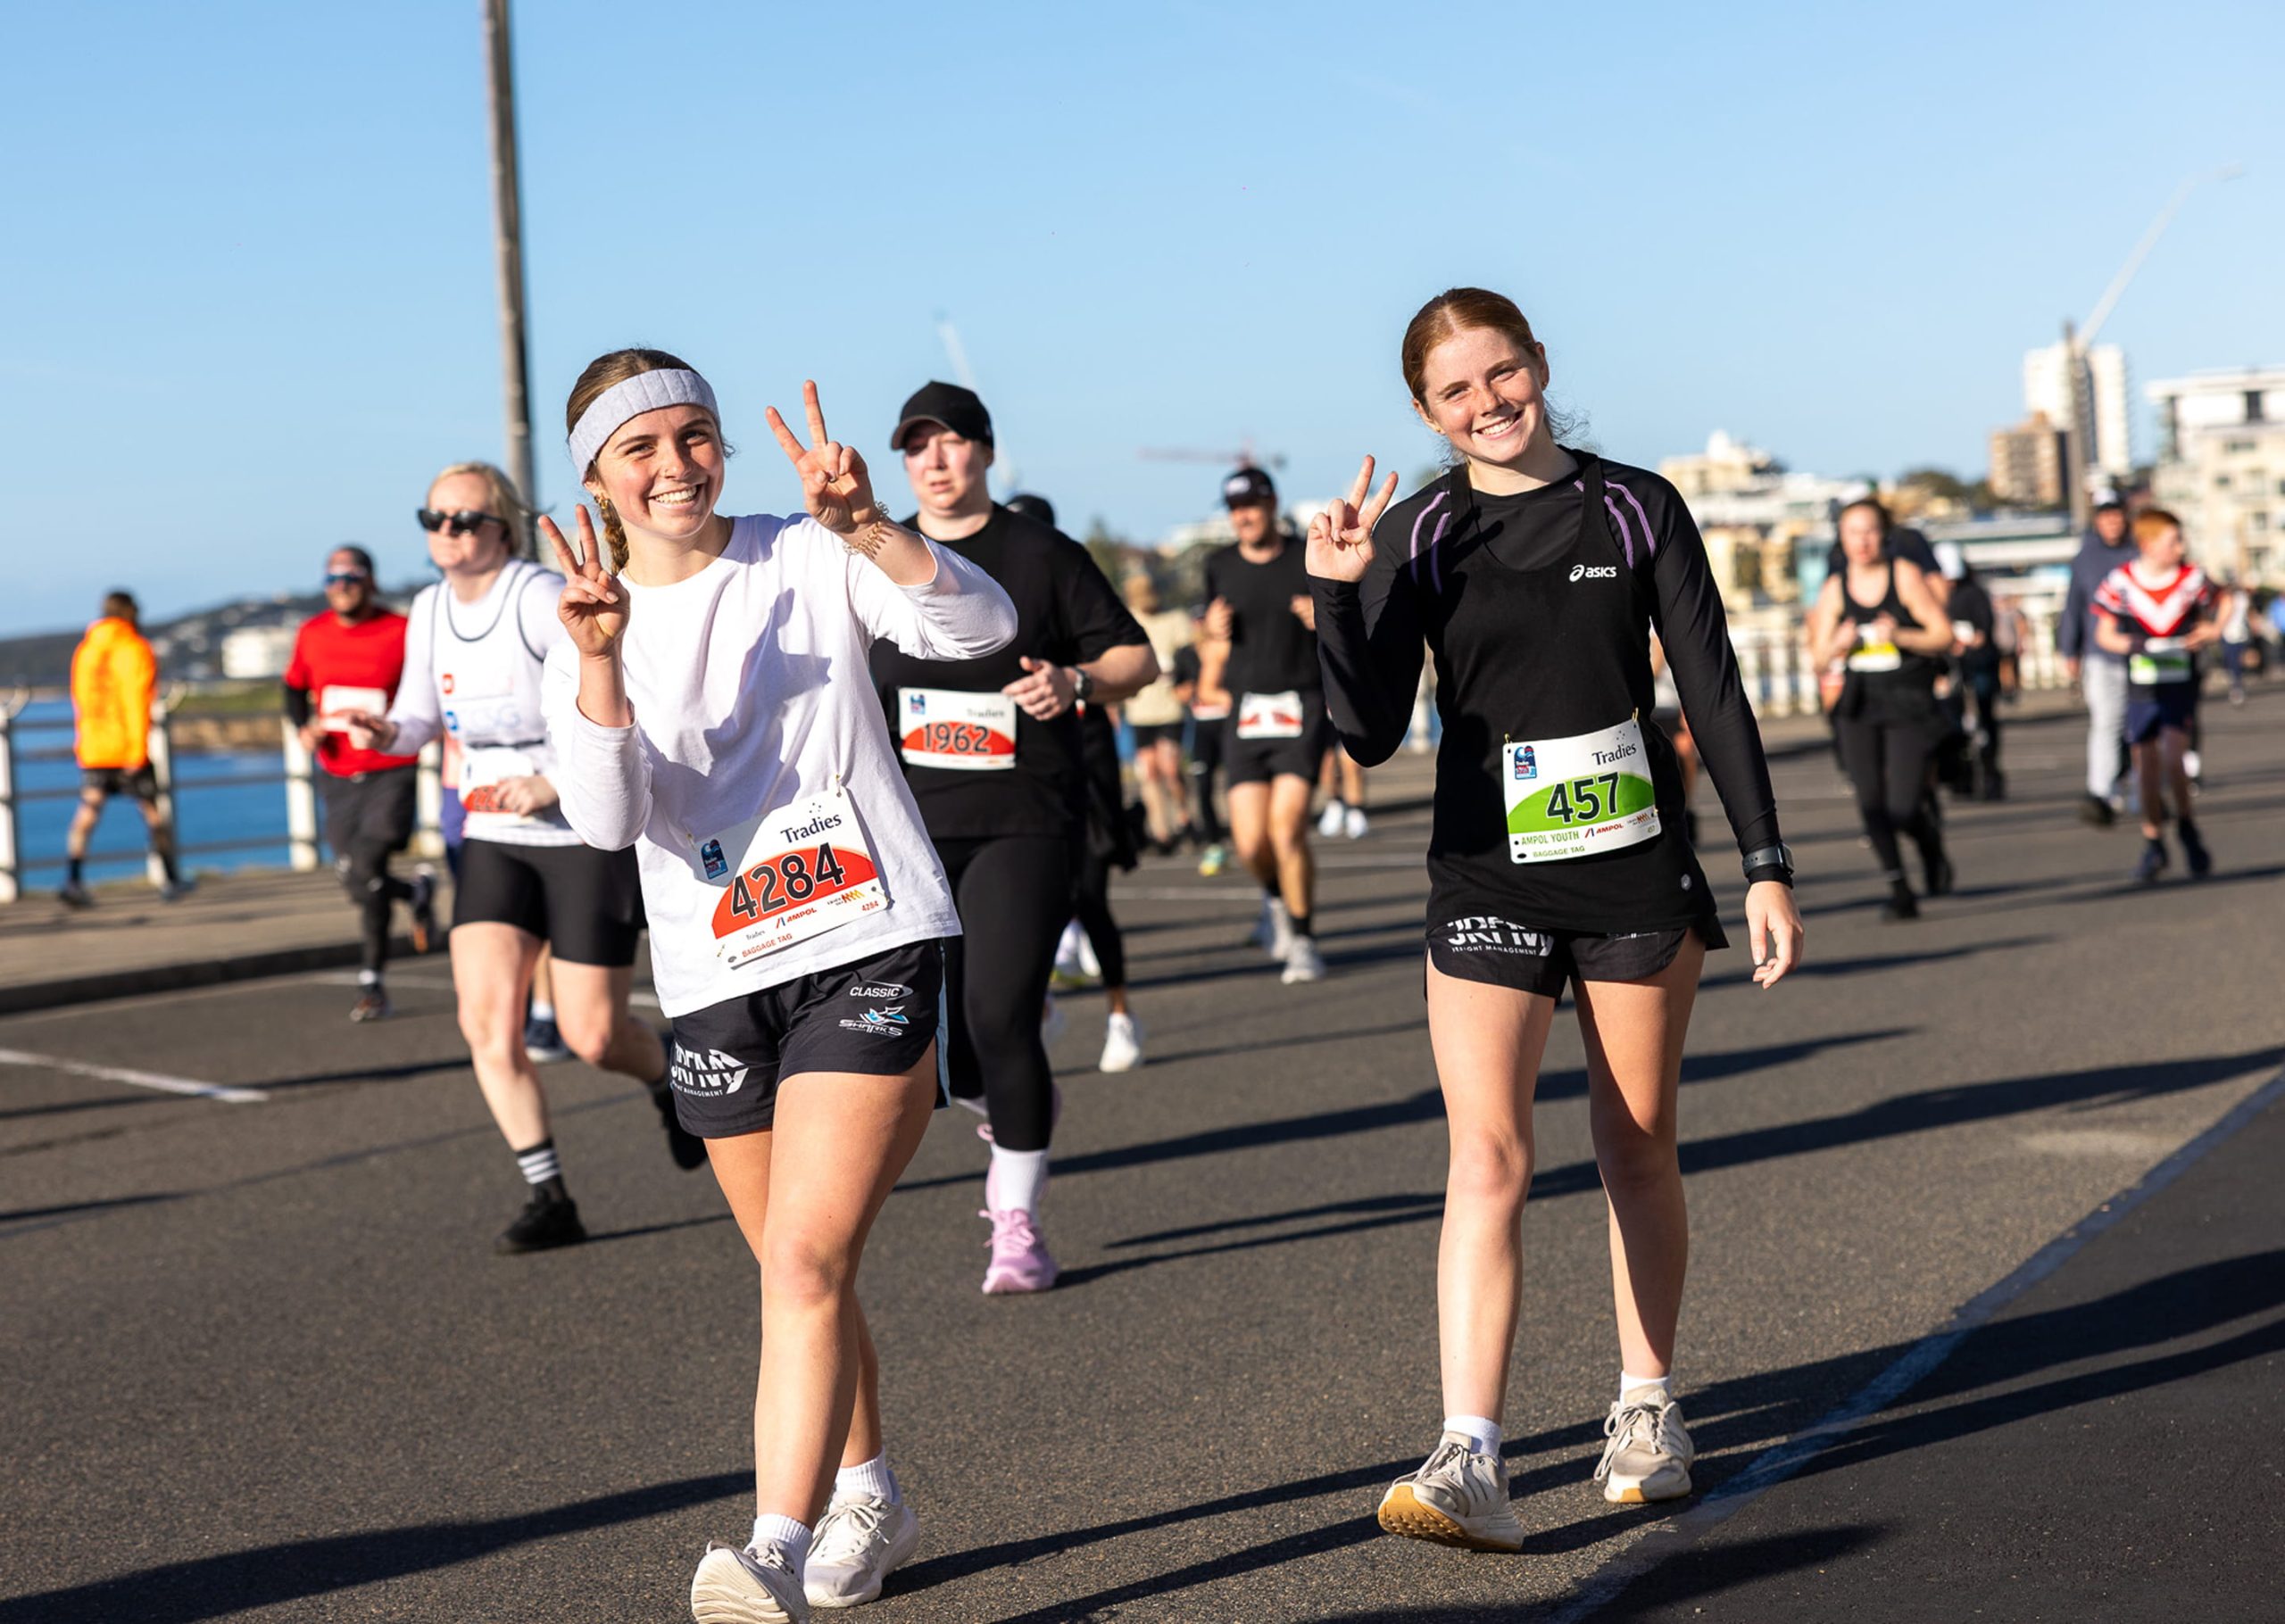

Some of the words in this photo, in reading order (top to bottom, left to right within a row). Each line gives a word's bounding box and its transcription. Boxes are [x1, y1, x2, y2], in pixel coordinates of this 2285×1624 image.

[925, 723, 989, 753] 1962
[1591, 742, 1637, 766] Tradies
[1547, 771, 1620, 824] 457
[780, 814, 842, 843] Tradies
[1597, 824, 1624, 833] AMPOL
[1521, 834, 1548, 845] AMPOL
[1550, 831, 1579, 842] YOUTH
[1533, 849, 1568, 858] BAGGAGE
[1571, 846, 1586, 854] TAG
[732, 842, 844, 919] 4284
[787, 907, 817, 923] AMPOL
[742, 939, 777, 957] BAGGAGE
[777, 933, 793, 942] TAG
[1485, 946, 1537, 956] MANAGEMENT
[850, 987, 900, 998] CLASSIC
[839, 1019, 903, 1036] SHARKS
